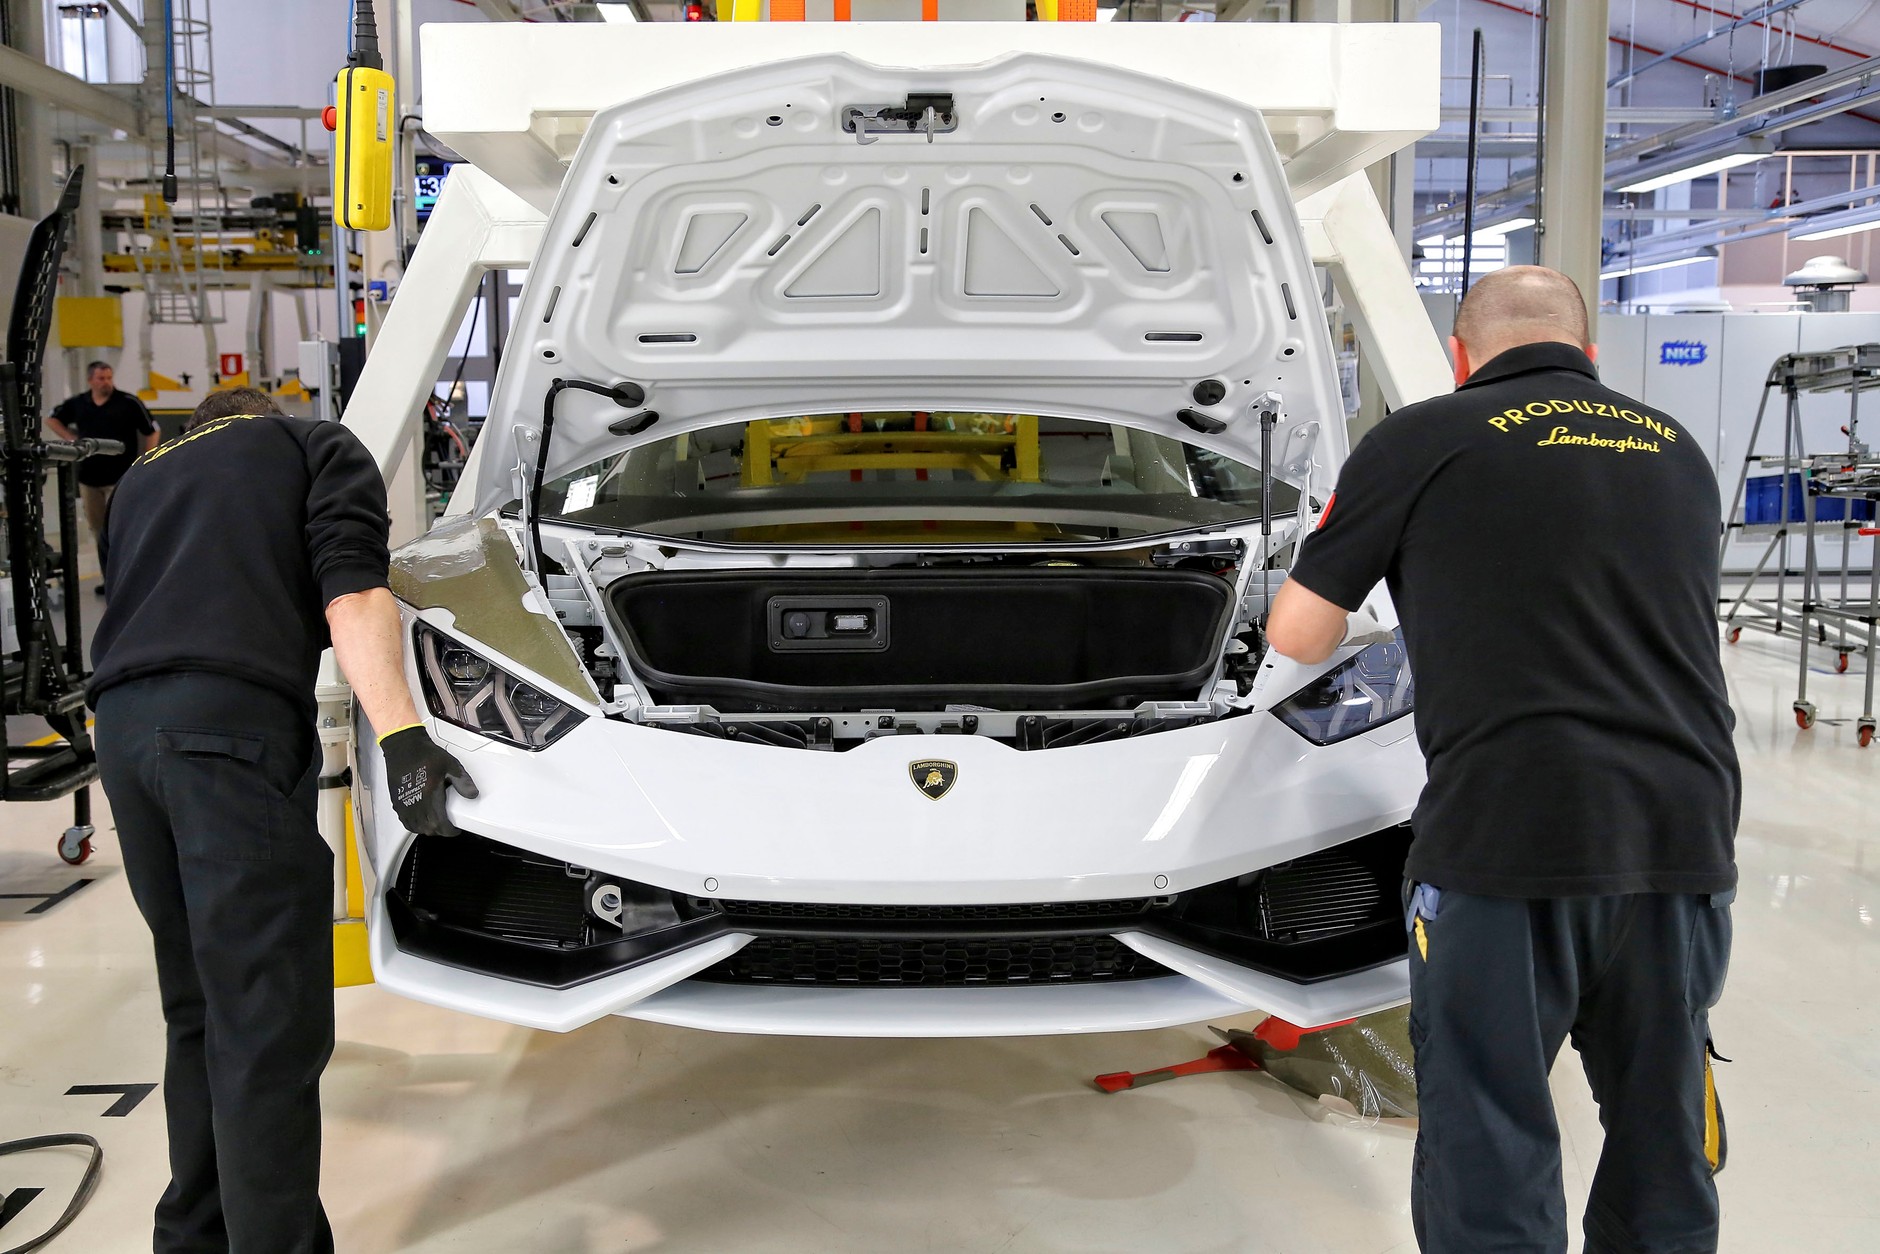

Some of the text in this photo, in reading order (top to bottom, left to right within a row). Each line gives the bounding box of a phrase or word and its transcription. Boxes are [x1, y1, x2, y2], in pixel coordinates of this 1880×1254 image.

[1665, 347, 1701, 360] NKE
[1487, 398, 1678, 443] PRODUZIONE
[1536, 426, 1660, 453] Lamborghini
[913, 762, 954, 770] LAMBORGHINI
